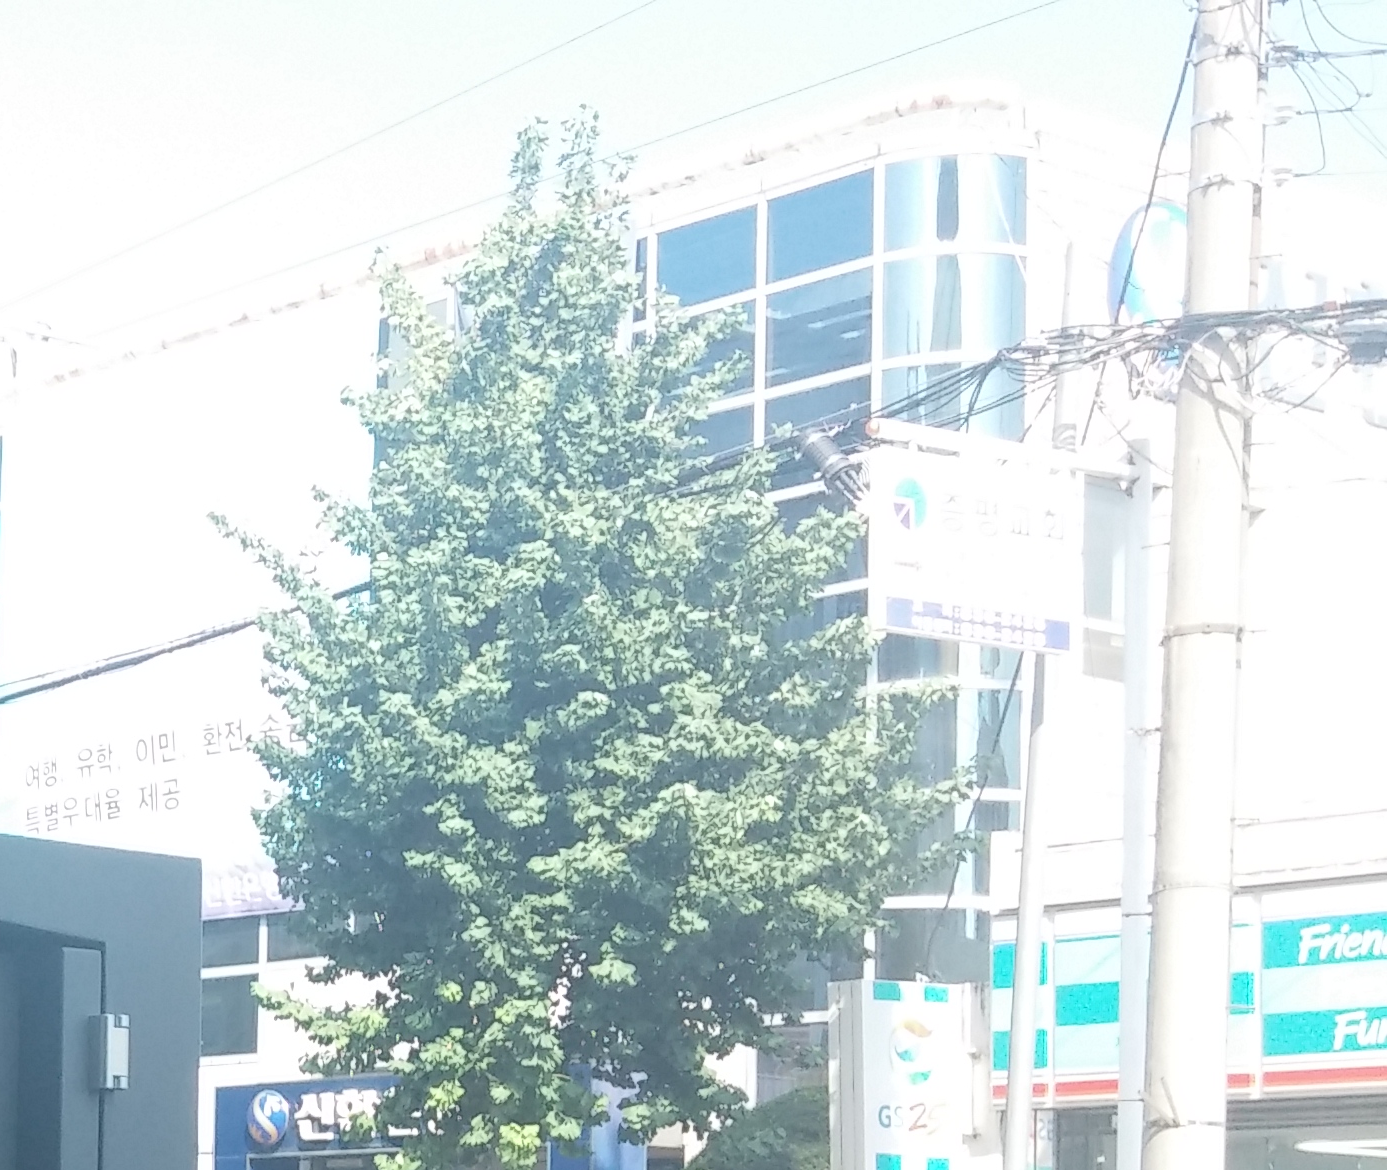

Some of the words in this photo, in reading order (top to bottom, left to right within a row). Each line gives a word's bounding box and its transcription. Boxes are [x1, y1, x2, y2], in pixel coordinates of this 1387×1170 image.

[139, 778, 180, 812] 제공
[1298, 923, 1387, 965] Frien
[877, 1102, 949, 1136] GS25
